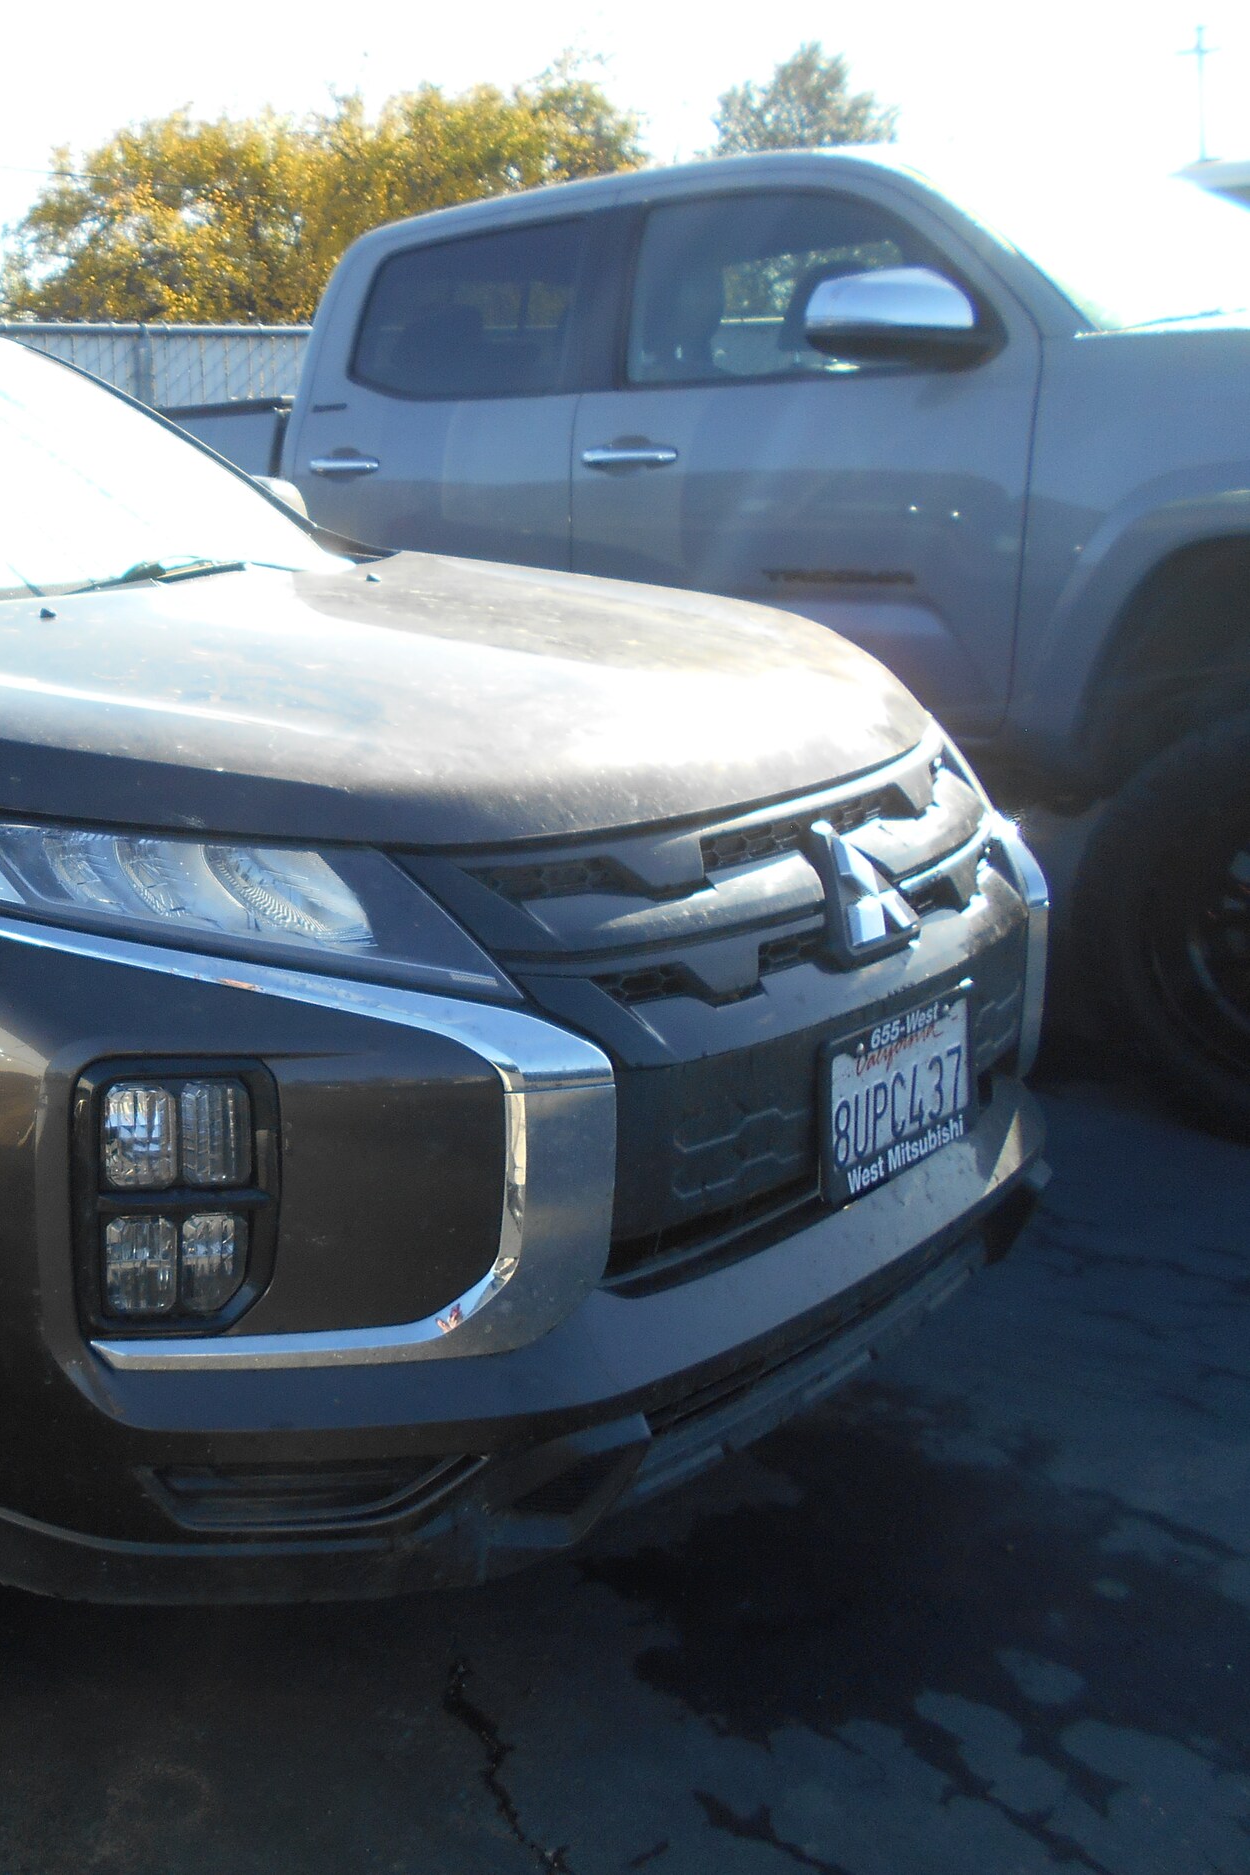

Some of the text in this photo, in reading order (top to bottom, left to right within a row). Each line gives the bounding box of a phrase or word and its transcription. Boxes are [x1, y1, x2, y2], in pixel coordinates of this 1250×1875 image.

[870, 1001, 940, 1049] 655-West
[834, 1042, 962, 1168] 8UPC437
[847, 1114, 965, 1194] West Mitsubishi
